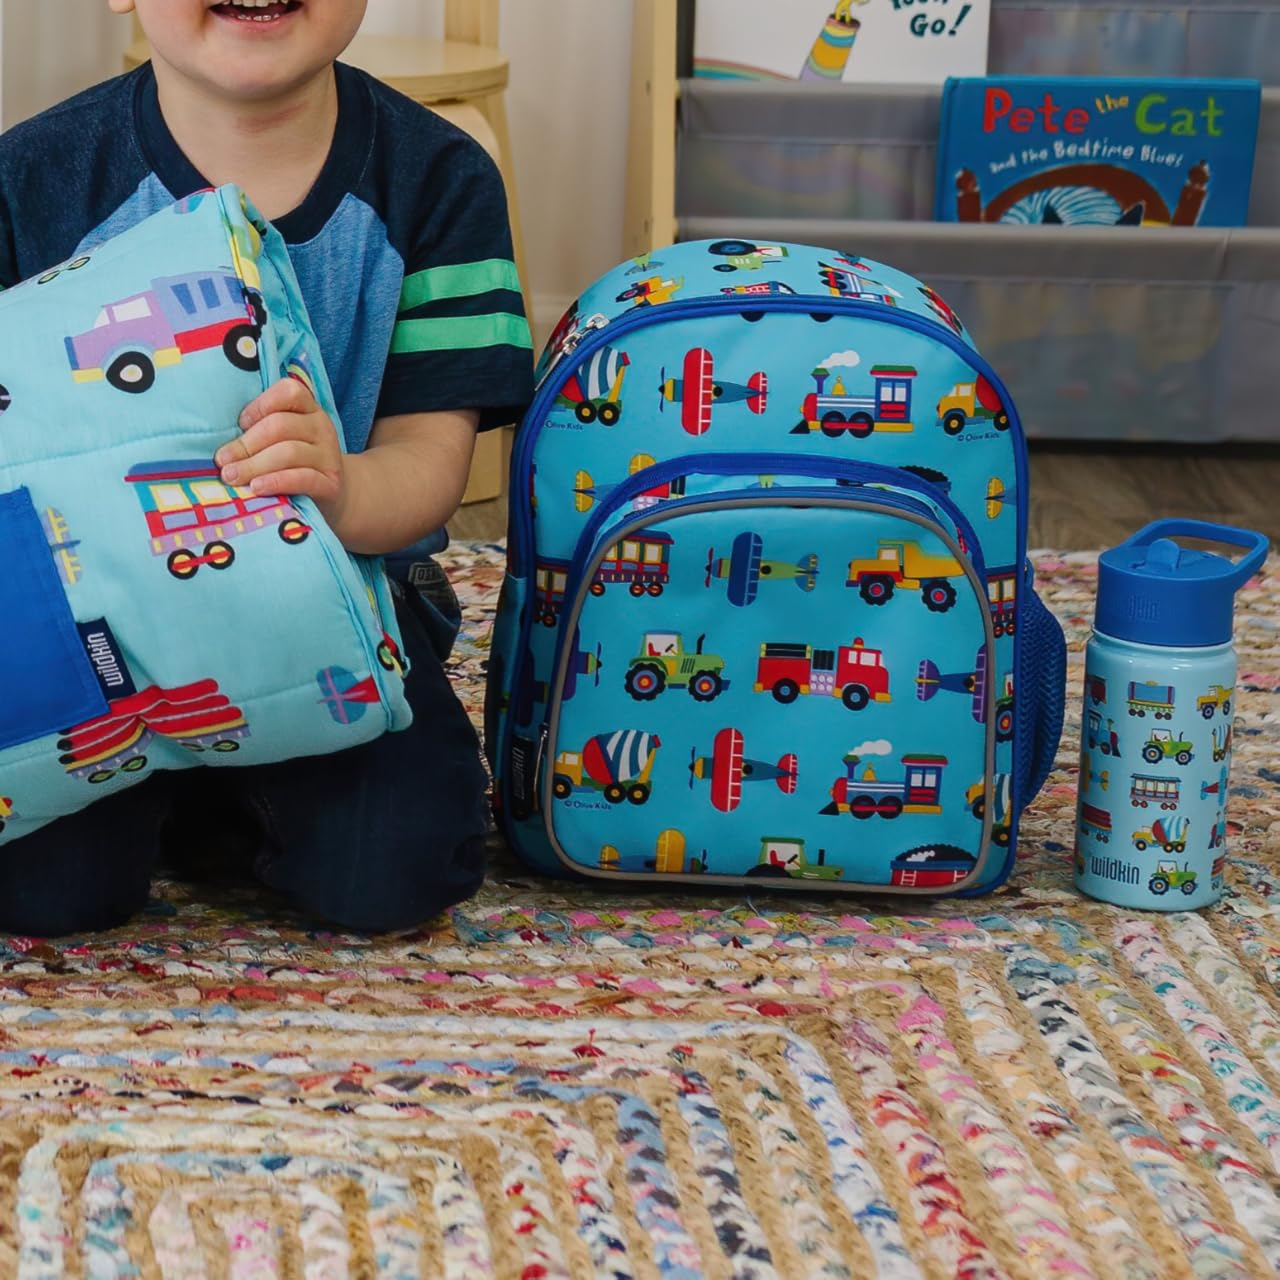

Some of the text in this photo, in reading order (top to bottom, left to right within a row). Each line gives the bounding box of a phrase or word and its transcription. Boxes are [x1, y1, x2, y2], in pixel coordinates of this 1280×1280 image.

[909, 4, 972, 37] Go!
[983, 87, 1224, 136] Pete the Cat
[989, 137, 1185, 174] and the Bedtime Blues
[87, 631, 124, 687] wildkin
[1091, 856, 1140, 885] wildkin
